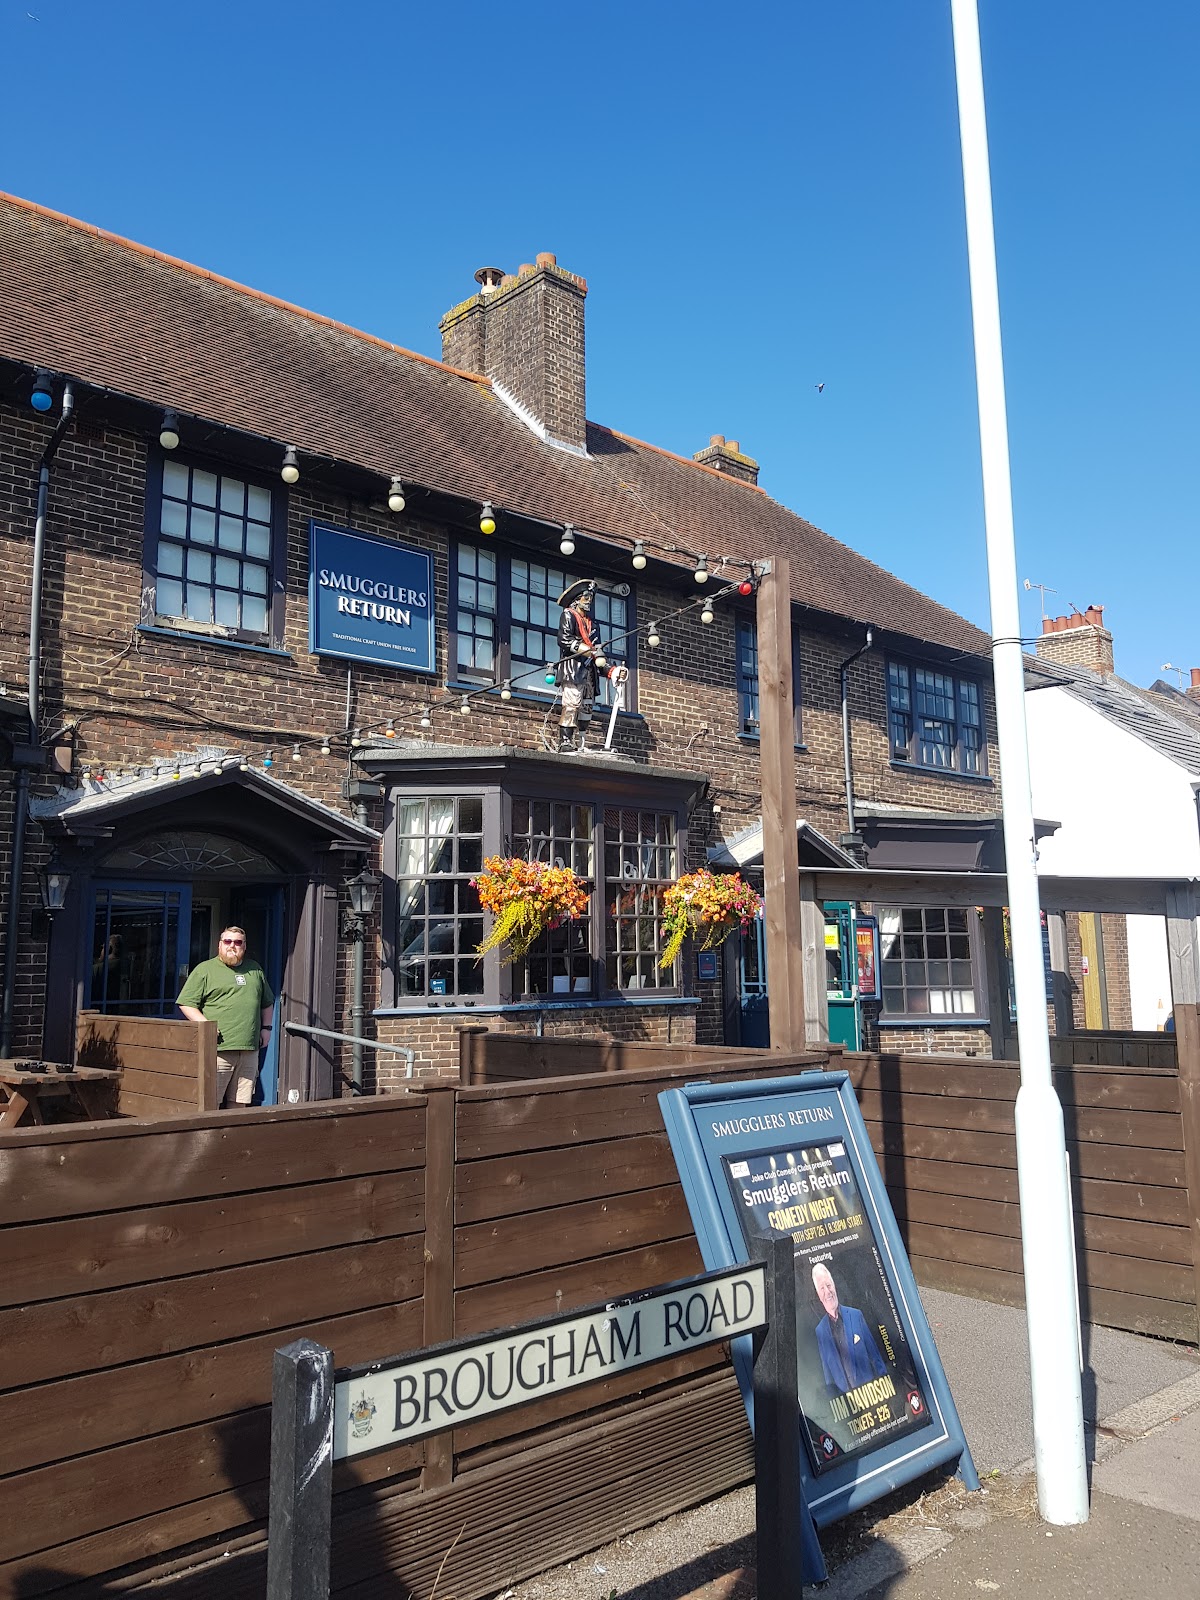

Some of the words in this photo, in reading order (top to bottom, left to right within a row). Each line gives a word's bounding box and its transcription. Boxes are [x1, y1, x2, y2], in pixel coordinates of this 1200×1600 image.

[320, 569, 427, 608] SMUGGLERS
[337, 595, 411, 626] RETURN
[332, 632, 362, 643] TRADITIONAL
[363, 638, 377, 646] CRAFT
[711, 1112, 786, 1138] SMUGGLERS
[787, 1106, 834, 1126] RETURN
[764, 1171, 776, 1180] Club
[777, 1166, 798, 1177] Comedy
[811, 1160, 833, 1170] presents
[742, 1180, 809, 1207] Smugglers
[808, 1170, 851, 1192] Return
[768, 1204, 811, 1231] COMEDY
[809, 1196, 838, 1221] NIGHT
[804, 1227, 818, 1240] SEPT
[846, 1214, 863, 1229] START
[808, 1252, 833, 1264] Featuring
[391, 1310, 642, 1433] BROUGHAM
[663, 1280, 754, 1347] ROAD
[878, 1324, 895, 1361] SUPPORT
[829, 1395, 850, 1423] JIM
[846, 1375, 897, 1415] DAVIDSON
[847, 1411, 875, 1436] TICKETS
[876, 1404, 891, 1422] £25
